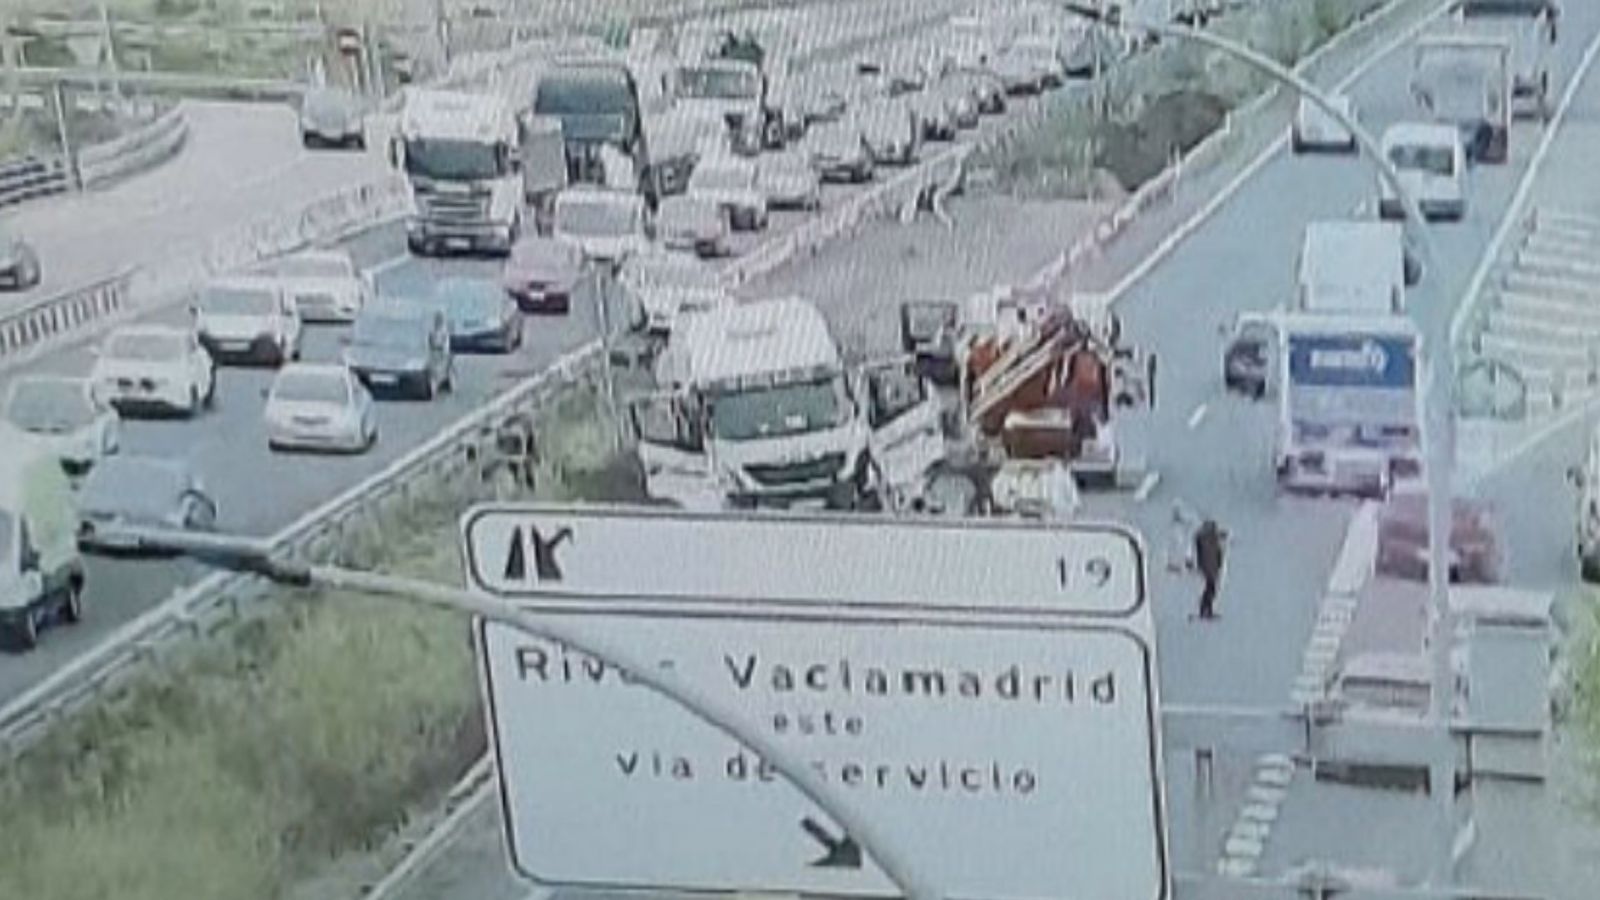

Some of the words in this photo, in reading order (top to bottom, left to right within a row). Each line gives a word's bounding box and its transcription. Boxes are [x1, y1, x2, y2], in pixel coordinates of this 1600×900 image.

[1056, 556, 1112, 589] 19
[515, 646, 676, 683] Riv
[723, 653, 1117, 704] Vaciamadrid
[772, 710, 864, 735] este
